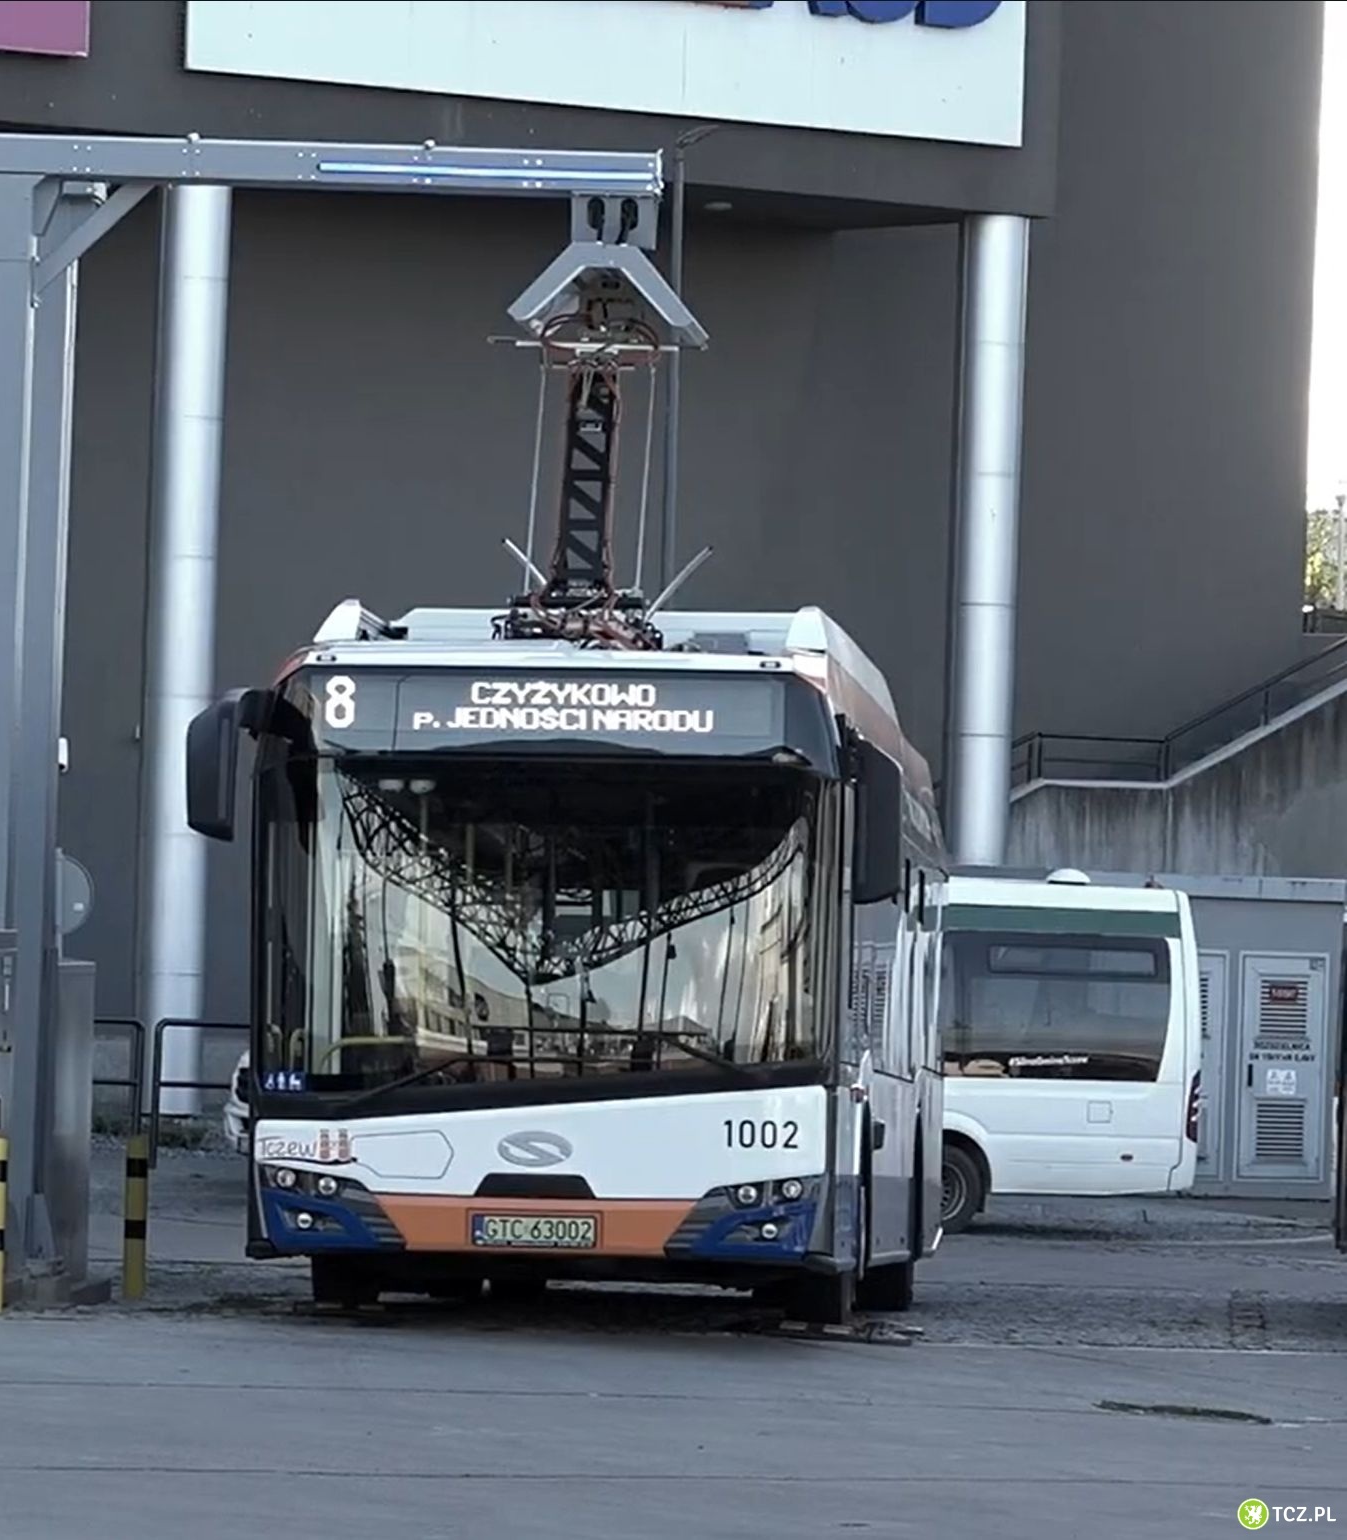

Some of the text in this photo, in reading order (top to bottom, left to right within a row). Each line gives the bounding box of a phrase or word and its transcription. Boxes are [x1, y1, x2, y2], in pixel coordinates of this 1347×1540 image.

[325, 675, 356, 728] 8
[471, 681, 656, 707] CZYŻYKOWO
[448, 706, 586, 731] JEDNOŚCI
[593, 710, 713, 732] NARODU
[258, 1136, 317, 1157] Tczew
[724, 1119, 798, 1149] 1002
[485, 1219, 591, 1240] GTC 63002
